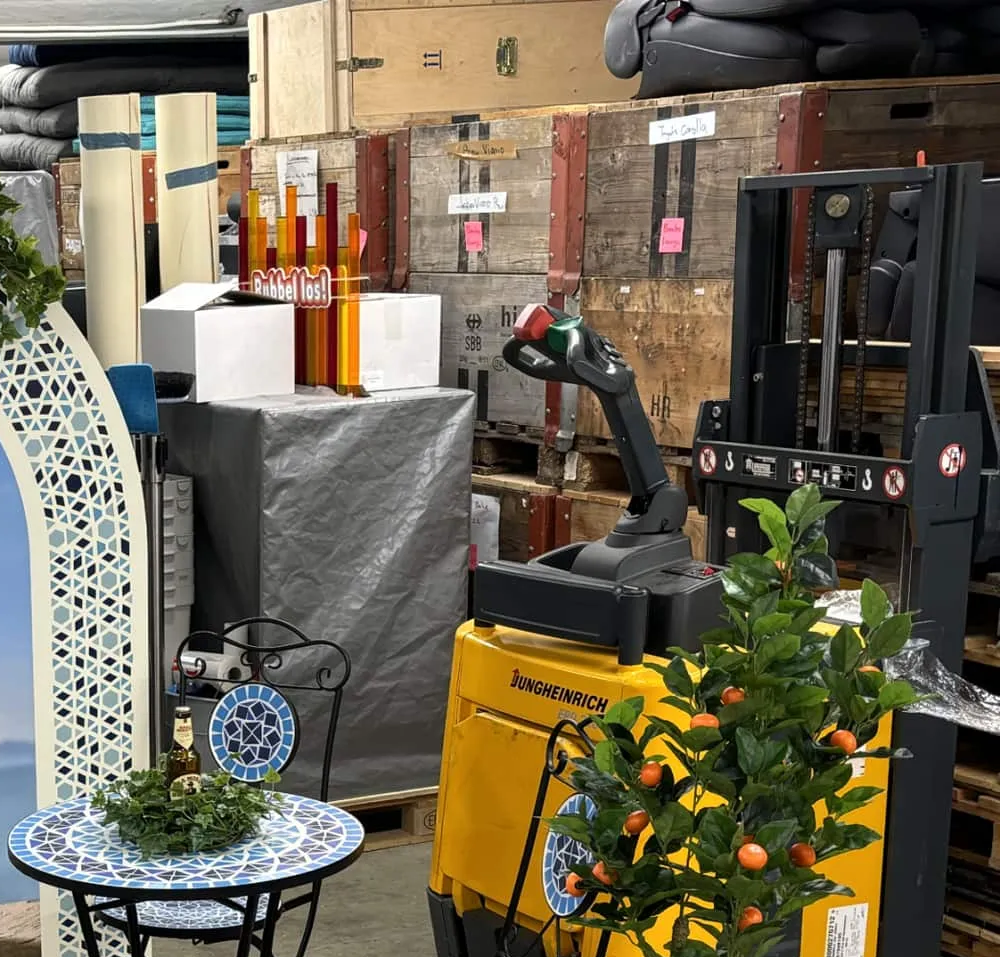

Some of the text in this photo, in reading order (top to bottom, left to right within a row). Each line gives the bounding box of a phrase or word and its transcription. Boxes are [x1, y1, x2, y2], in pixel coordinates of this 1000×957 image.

[301, 270, 327, 302] los!
[465, 336, 481, 351] SBB
[510, 673, 609, 713] JUNGHEINRICH
